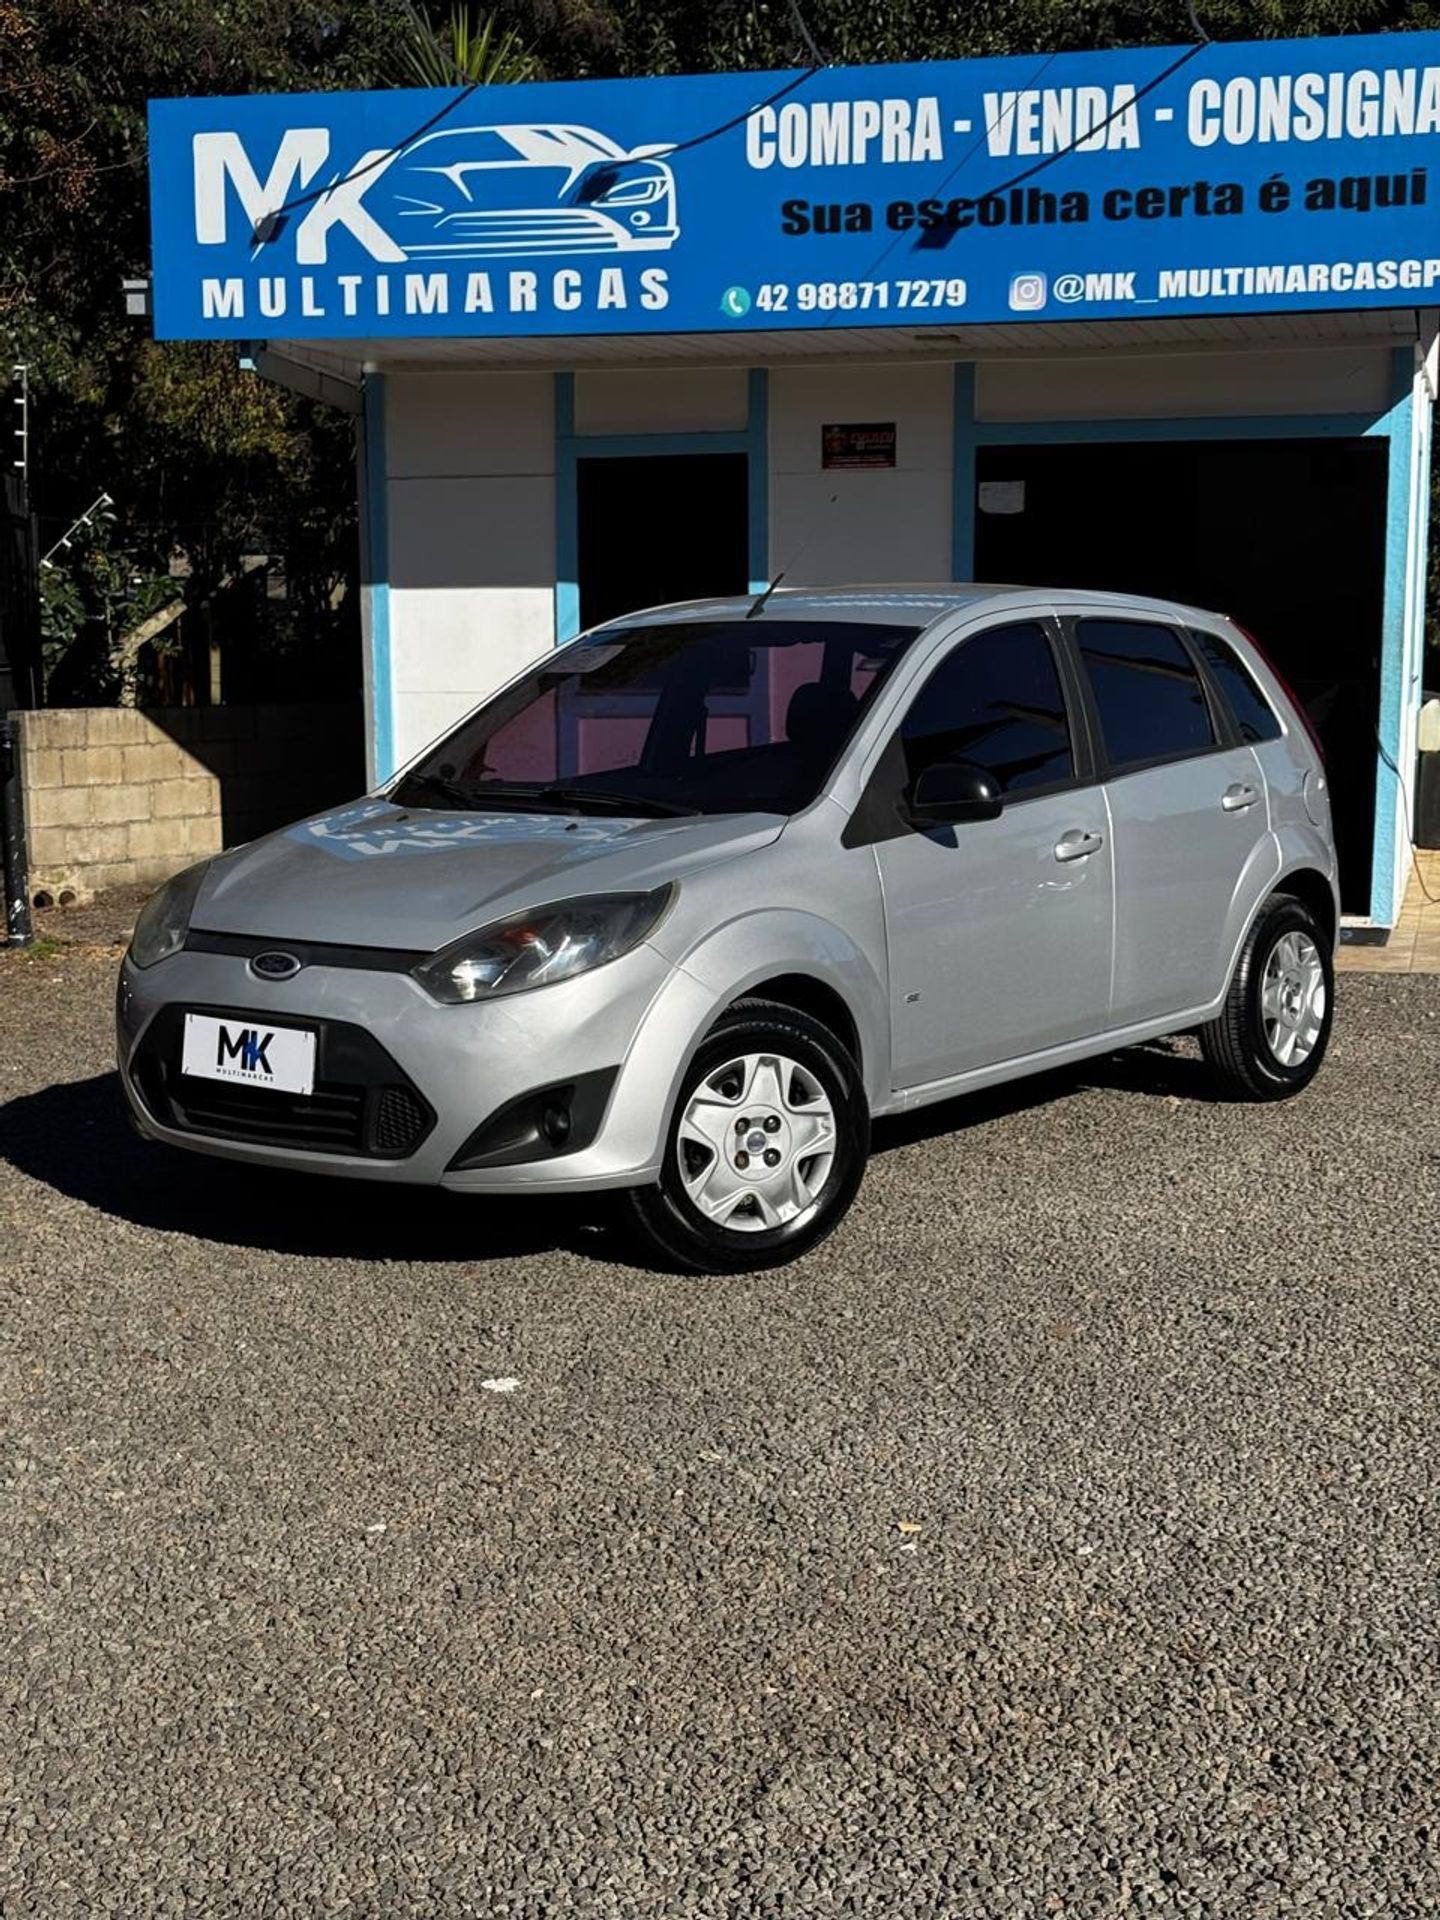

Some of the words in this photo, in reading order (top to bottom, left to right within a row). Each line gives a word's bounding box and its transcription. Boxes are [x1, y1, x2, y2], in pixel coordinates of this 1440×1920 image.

[746, 97, 943, 169] COMPRA
[954, 120, 971, 132] -
[983, 84, 1140, 157] VENDA
[1155, 108, 1173, 121] -
[1188, 67, 1440, 147] CONSIGNA
[193, 128, 408, 264] MK
[782, 199, 872, 235] Sua
[886, 187, 1089, 231] escolha
[1103, 180, 1243, 221] certa
[1259, 173, 1290, 213] é
[1305, 168, 1426, 212] aqui
[202, 268, 669, 318] MULTIMARCAS
[756, 284, 789, 312] 42
[797, 281, 888, 311] 98871
[895, 279, 966, 307] 7279
[217, 1025, 275, 1074] MK
[215, 1067, 275, 1083] MULTIMARCAS
